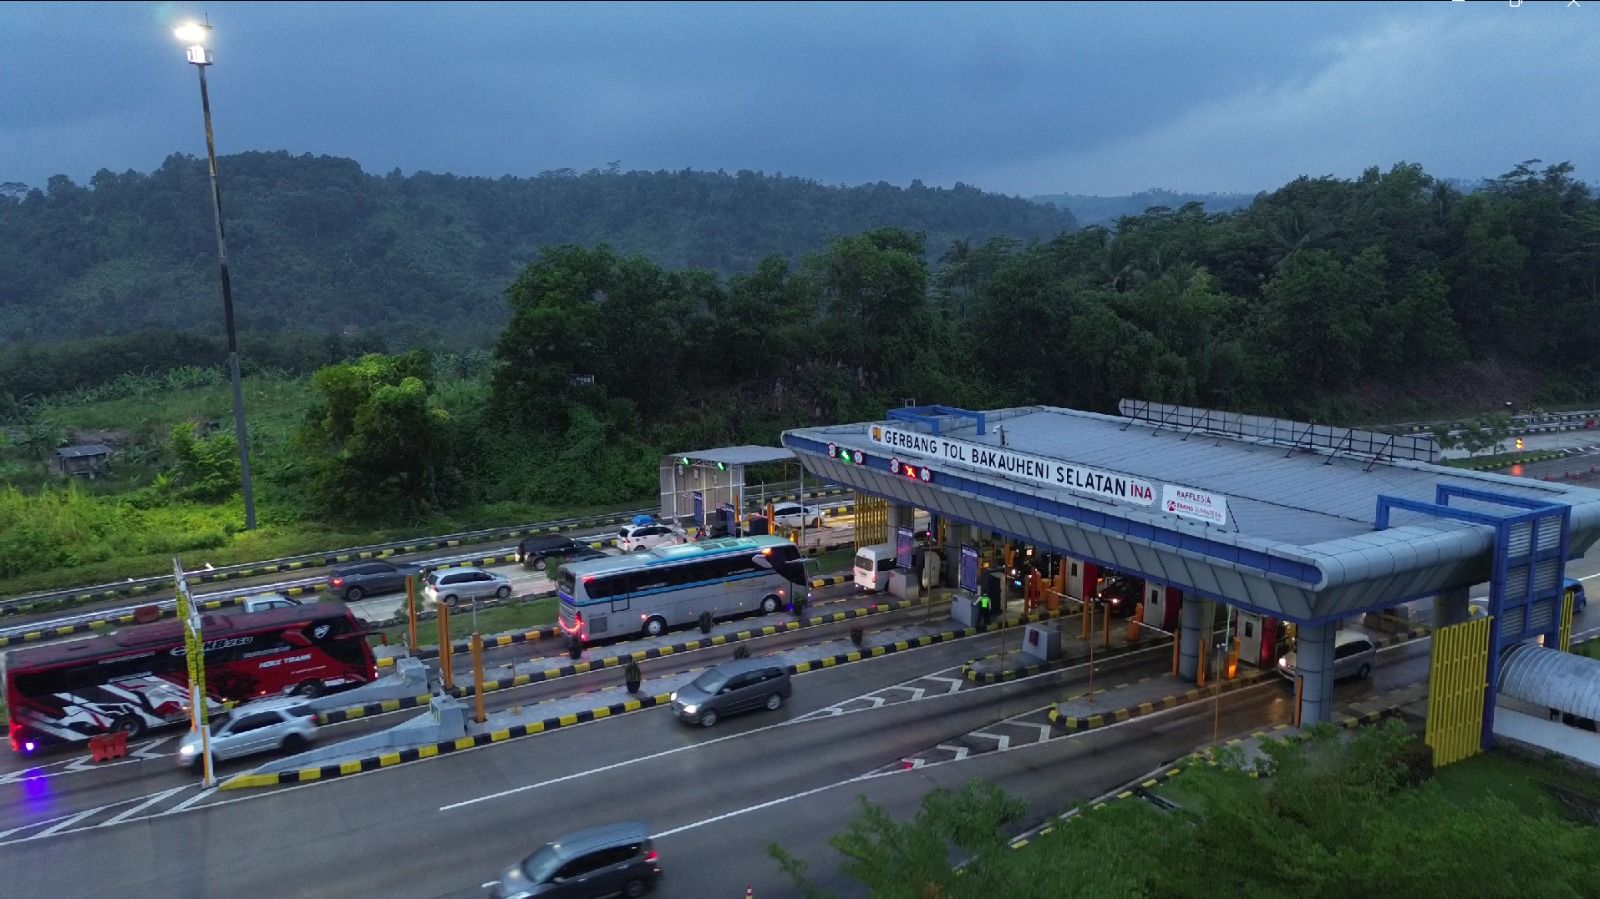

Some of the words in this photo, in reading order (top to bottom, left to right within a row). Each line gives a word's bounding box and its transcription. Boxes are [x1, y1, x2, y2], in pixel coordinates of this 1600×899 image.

[885, 430, 937, 453] GERBANG
[943, 442, 966, 461] TOL
[972, 448, 1049, 479] BAKAUHENI
[1056, 466, 1126, 497] SELATAN
